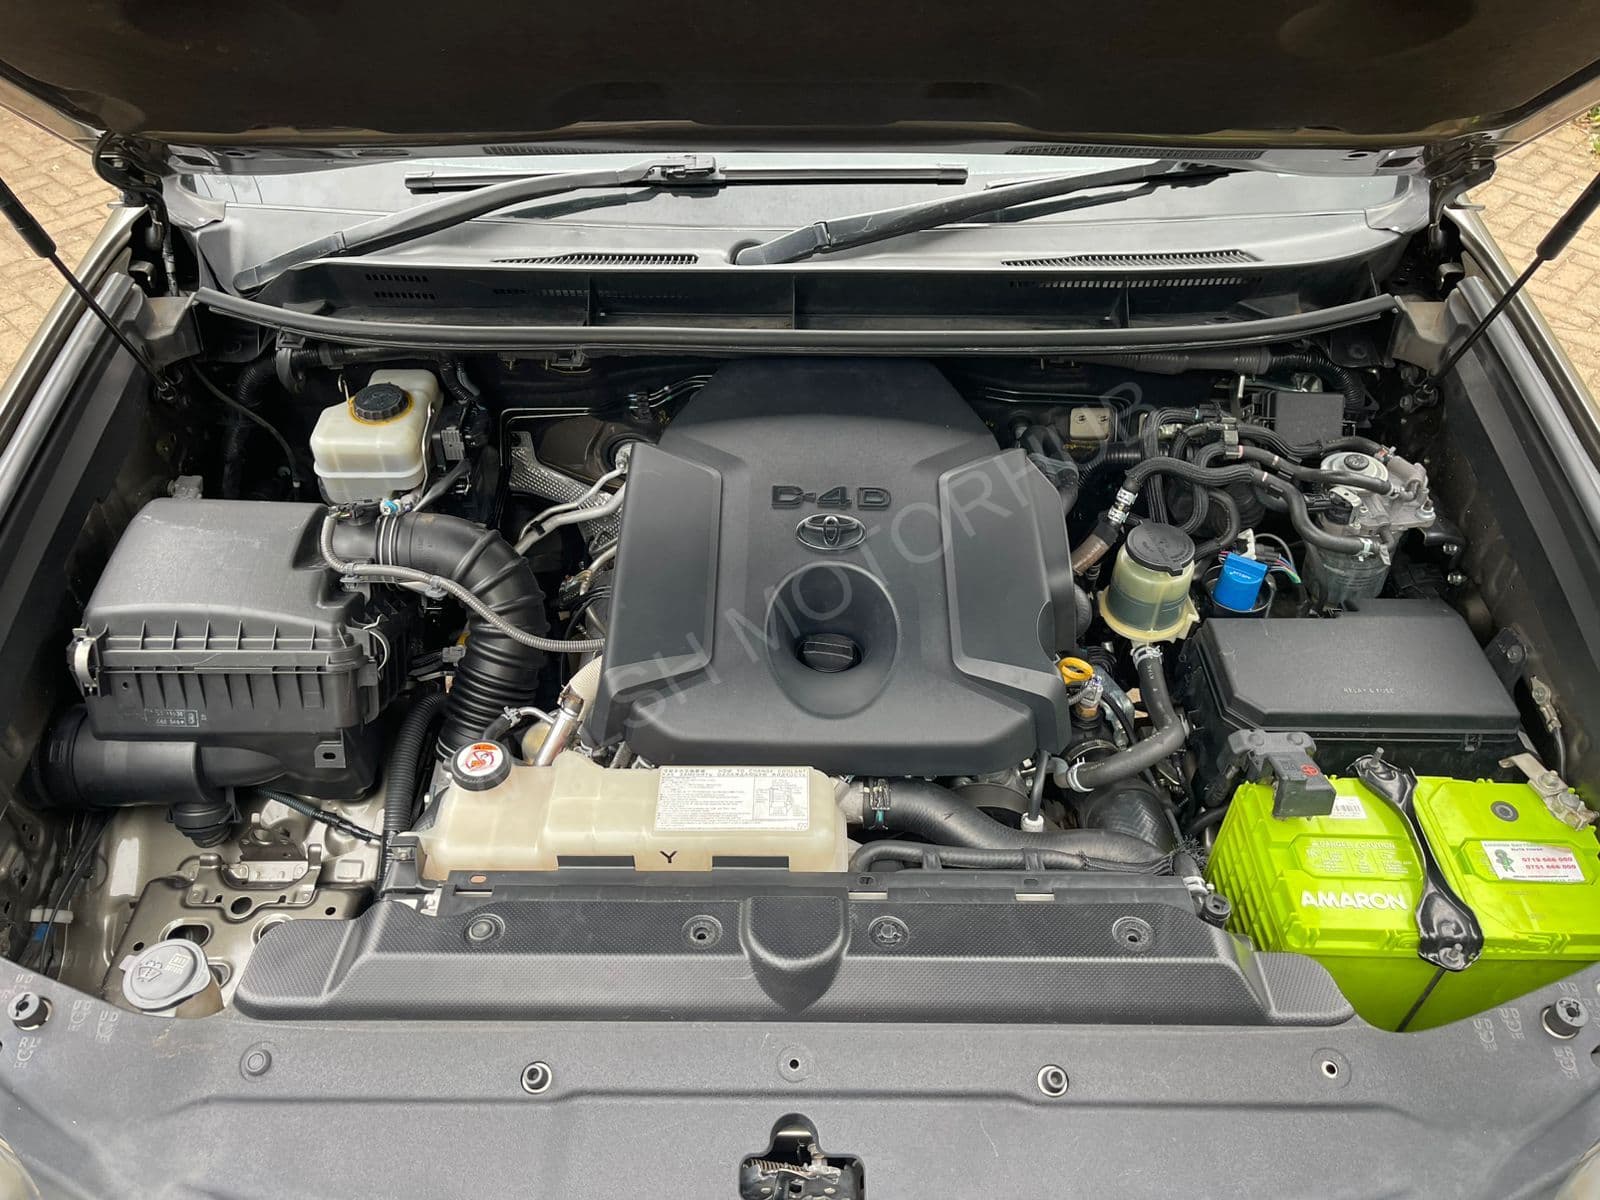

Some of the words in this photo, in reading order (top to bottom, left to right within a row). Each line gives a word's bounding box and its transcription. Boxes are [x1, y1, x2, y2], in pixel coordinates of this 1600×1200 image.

[772, 485, 891, 510] D-4D
[660, 850, 677, 864] Y
[1301, 890, 1408, 911] AMARON
